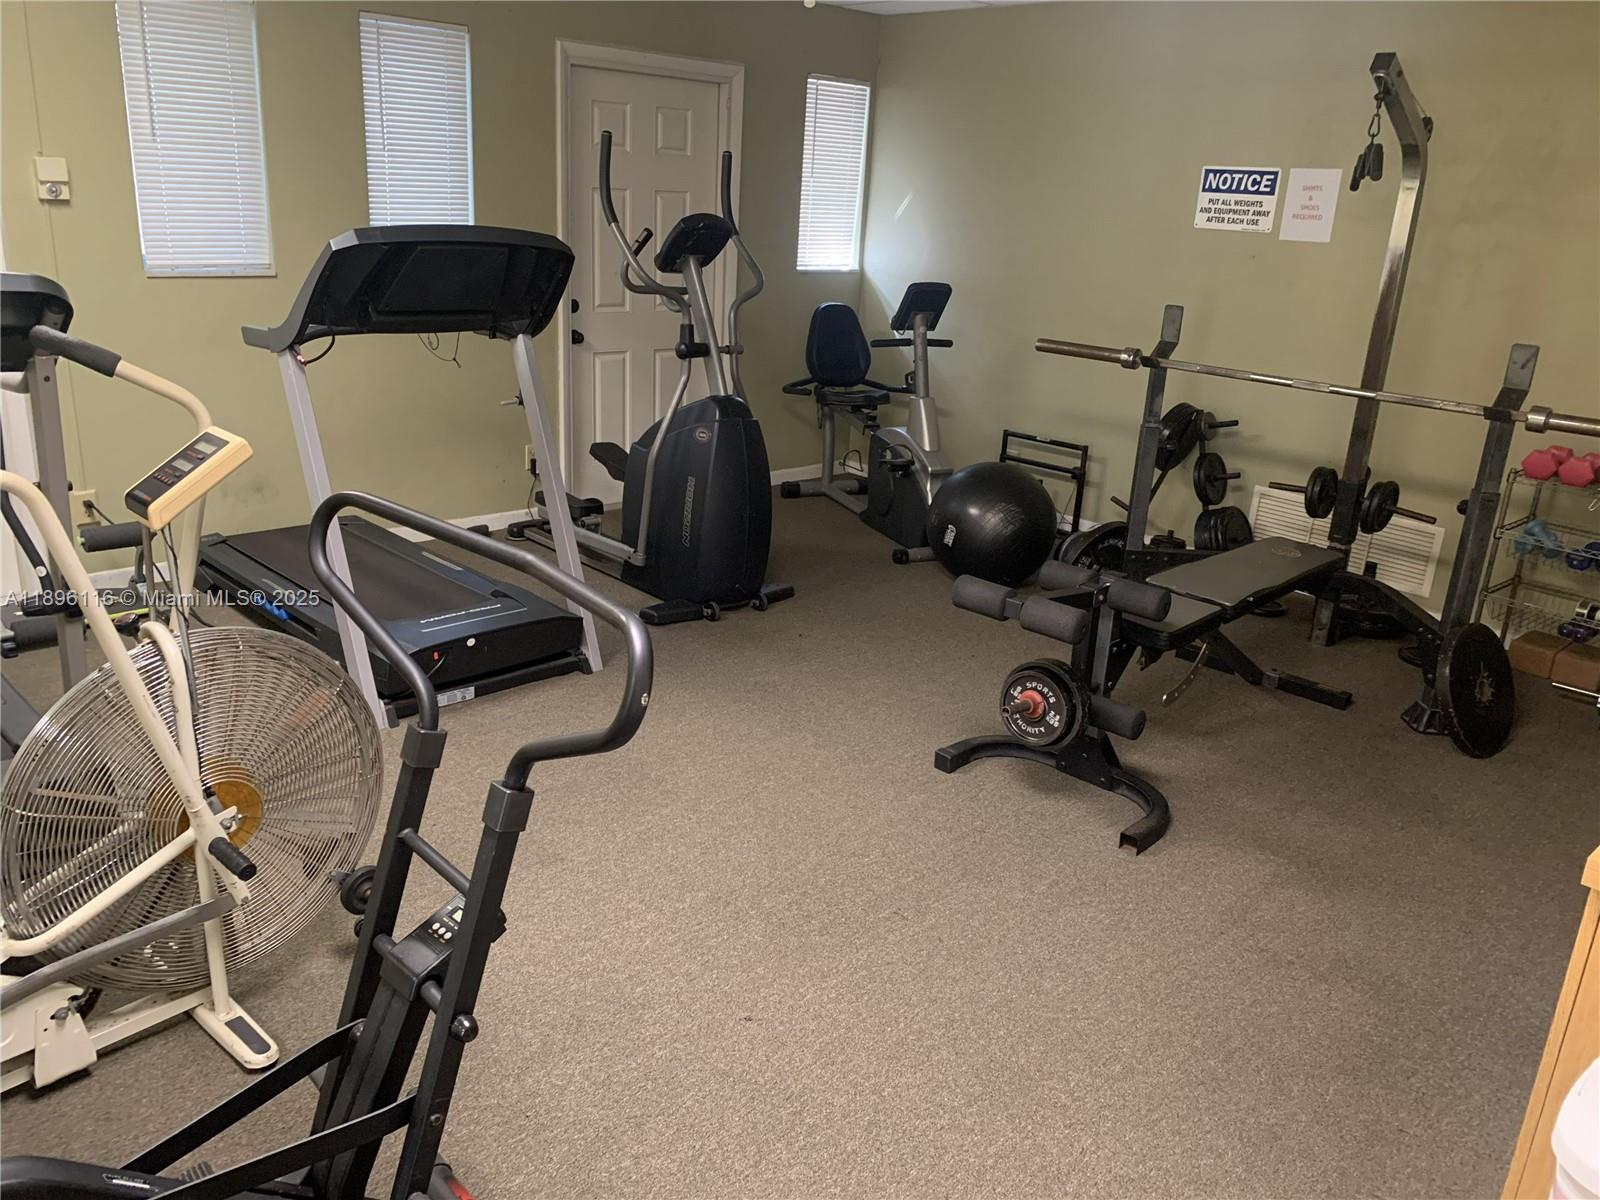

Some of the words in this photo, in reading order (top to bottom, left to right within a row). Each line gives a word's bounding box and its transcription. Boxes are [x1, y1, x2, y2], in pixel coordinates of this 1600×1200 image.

[1205, 173, 1274, 191] NOTICE
[1208, 198, 1220, 206] PUT
[1221, 198, 1232, 206] ALL
[1234, 199, 1264, 208] WEIGHTS
[1213, 207, 1250, 216] EQUIPMENT
[1251, 209, 1271, 217] AWAY
[1206, 216, 1226, 224] AFTER
[1227, 217, 1245, 225] EACH
[1246, 218, 1260, 226] USE
[1026, 681, 1056, 704] SPORTS
